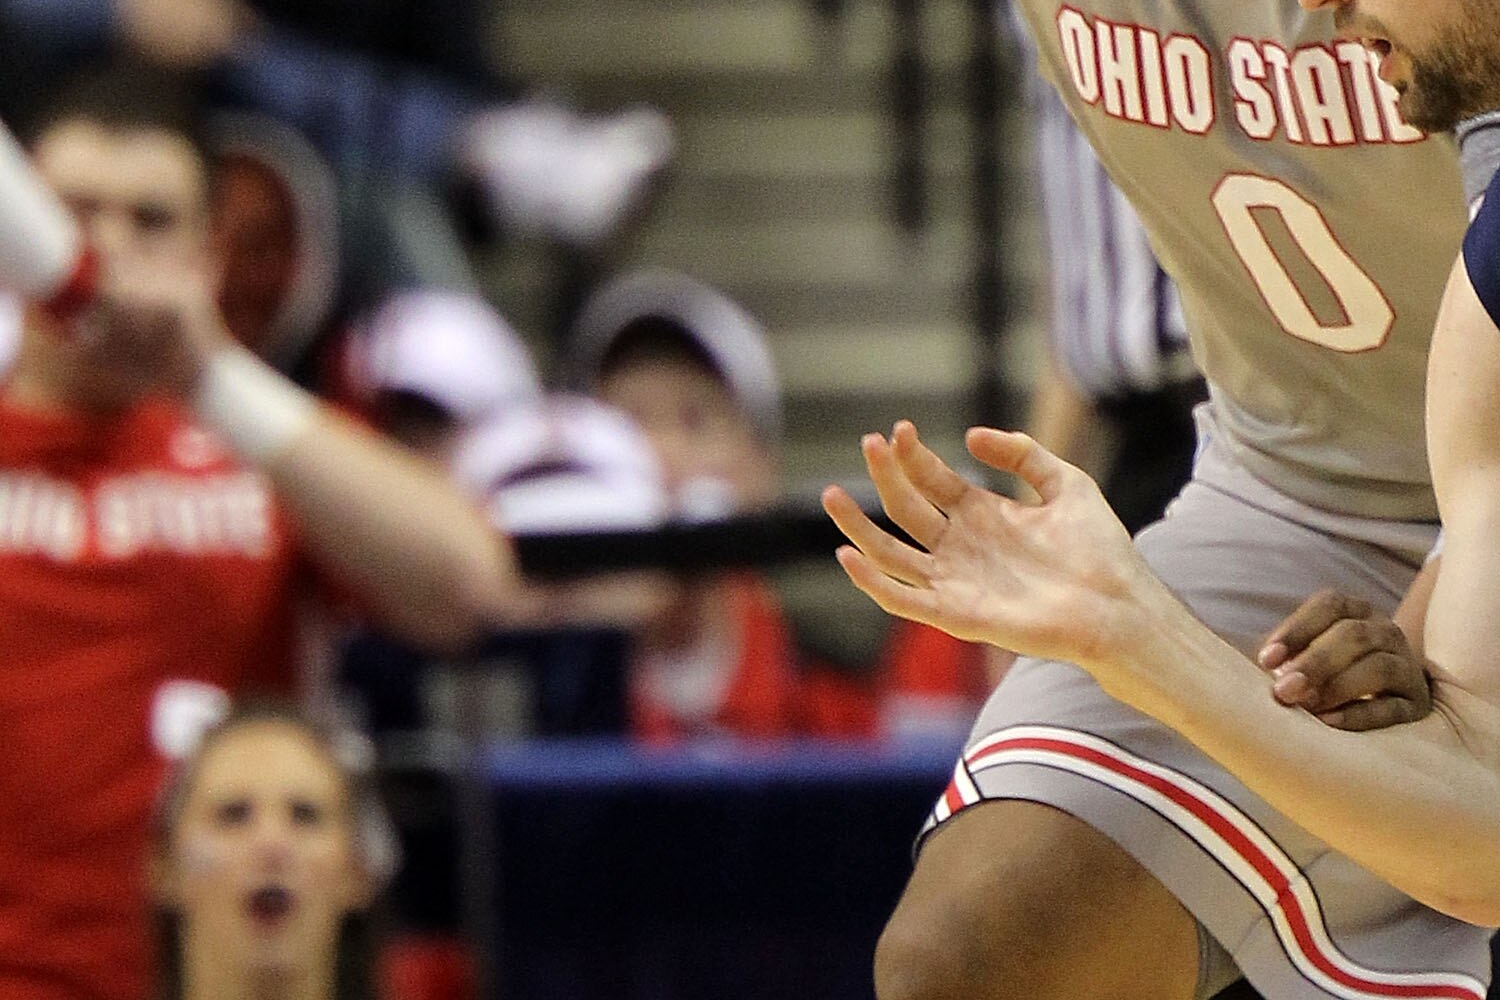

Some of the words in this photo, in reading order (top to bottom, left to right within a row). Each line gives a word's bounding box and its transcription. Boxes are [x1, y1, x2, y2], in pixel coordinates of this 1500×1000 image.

[1056, 3, 1215, 136] OHIO
[1228, 35, 1427, 147] STATE
[1209, 171, 1397, 353] 0
